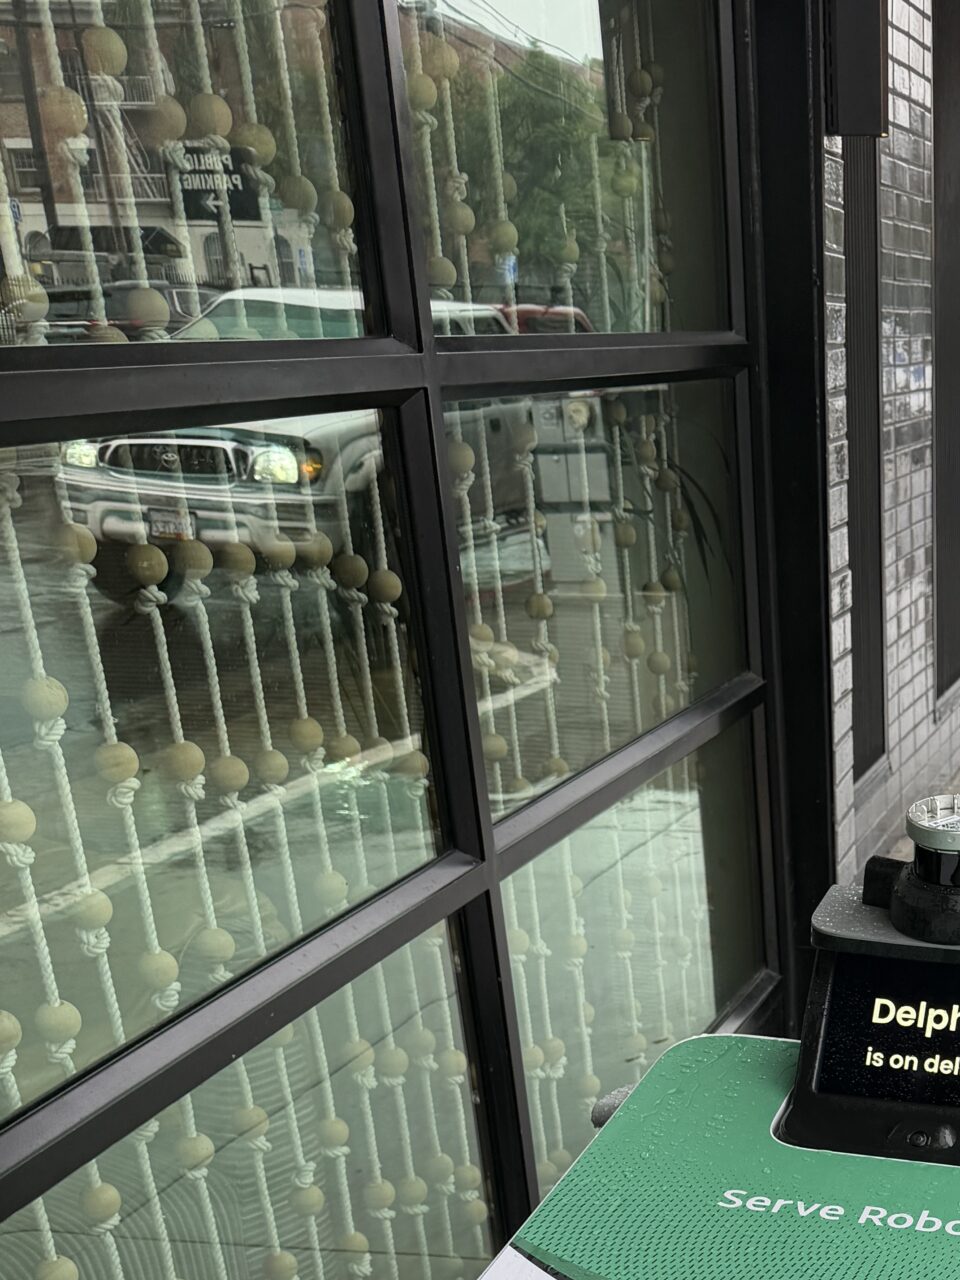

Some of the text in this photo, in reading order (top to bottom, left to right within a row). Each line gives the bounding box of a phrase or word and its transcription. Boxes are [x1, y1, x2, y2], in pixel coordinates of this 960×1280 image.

[865, 1046, 884, 1067] is
[889, 1053, 918, 1072] on
[717, 1189, 845, 1221] Serve
